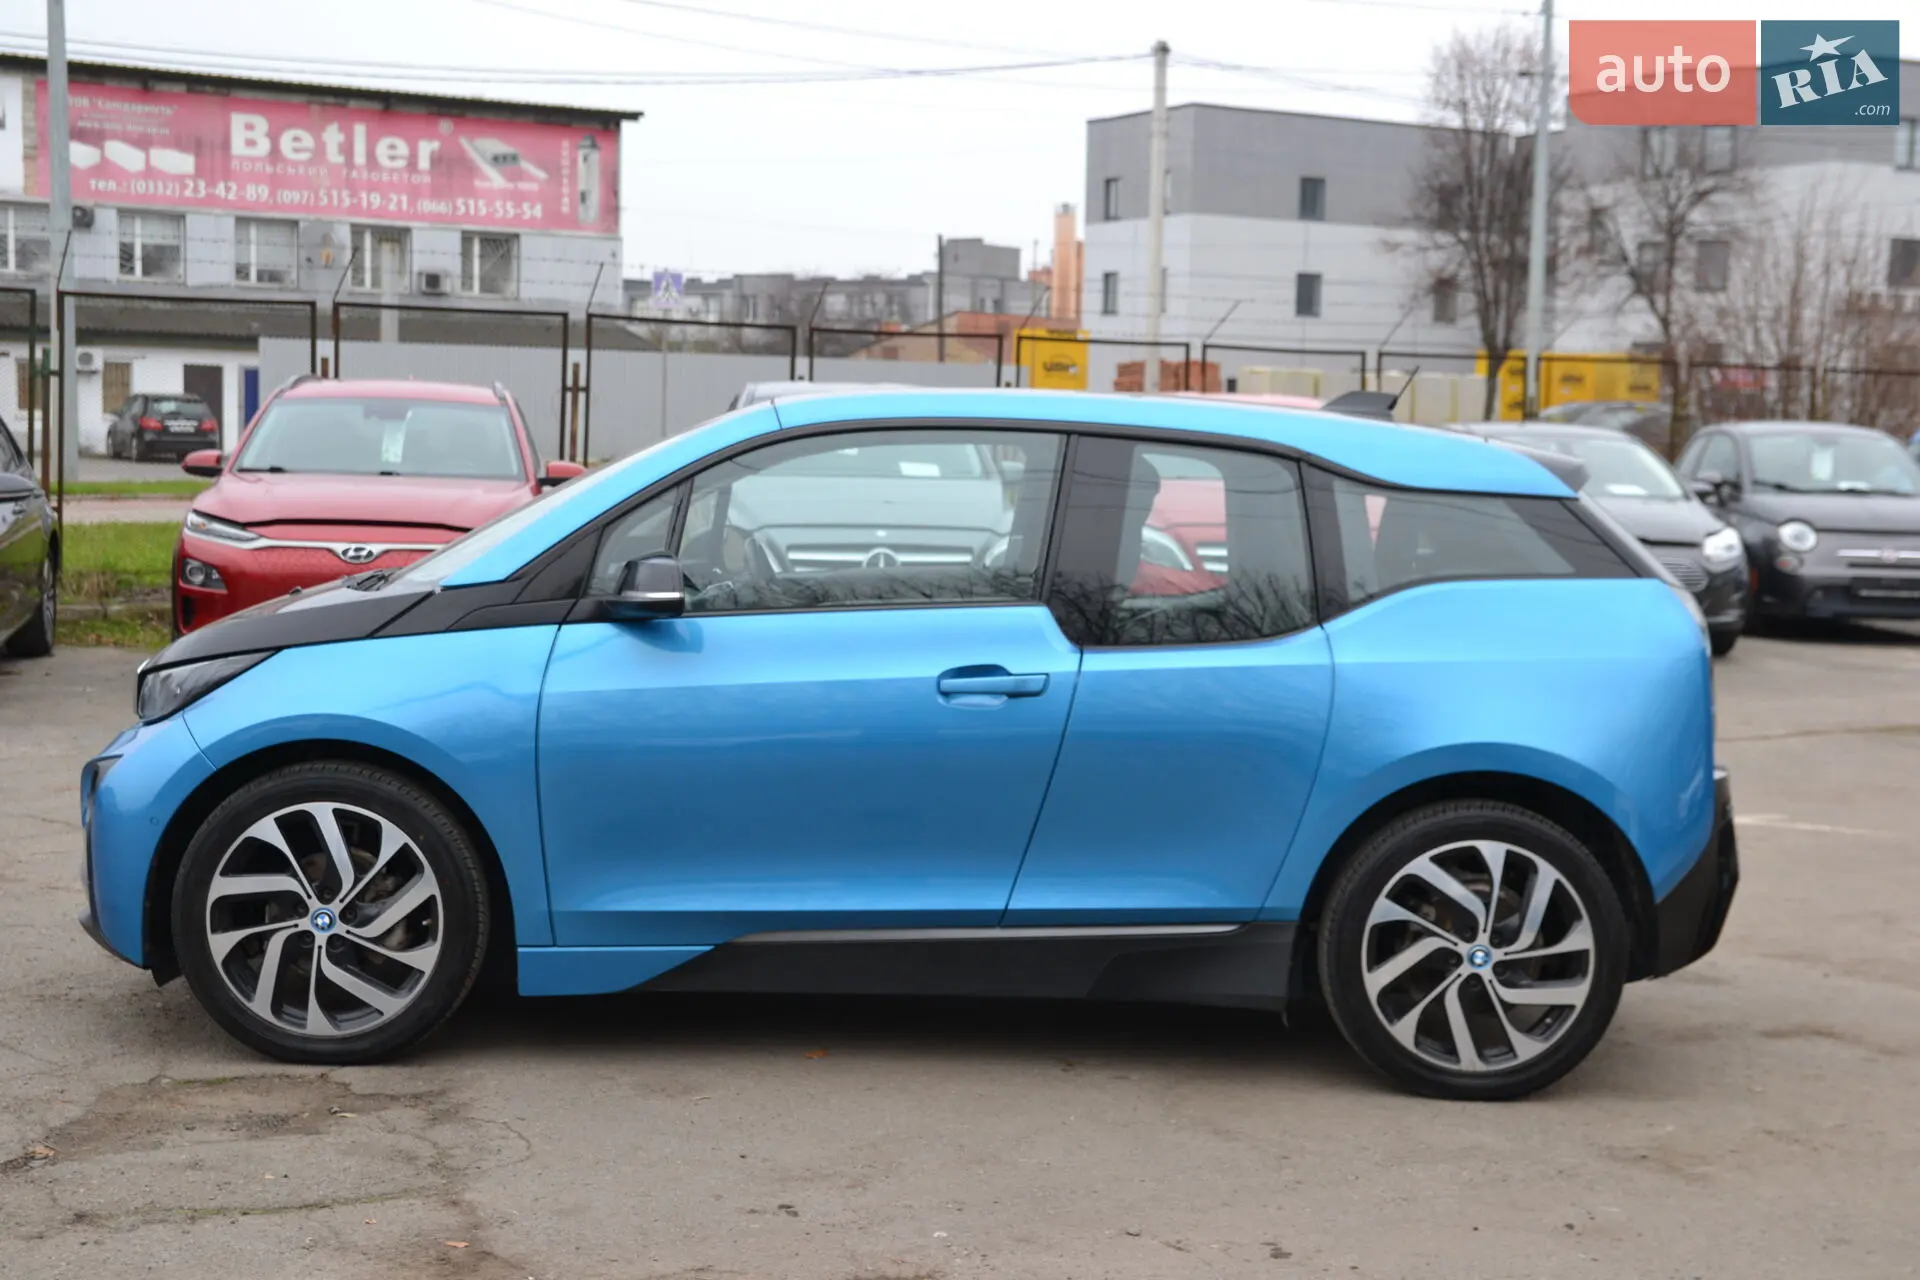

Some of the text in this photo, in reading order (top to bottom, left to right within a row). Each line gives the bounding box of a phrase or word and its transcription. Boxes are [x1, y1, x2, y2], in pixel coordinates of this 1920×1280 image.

[230, 112, 441, 171] Betler
[130, 179, 180, 198] (0332)
[277, 189, 315, 206] (097)
[455, 197, 543, 220] 515-55-54
